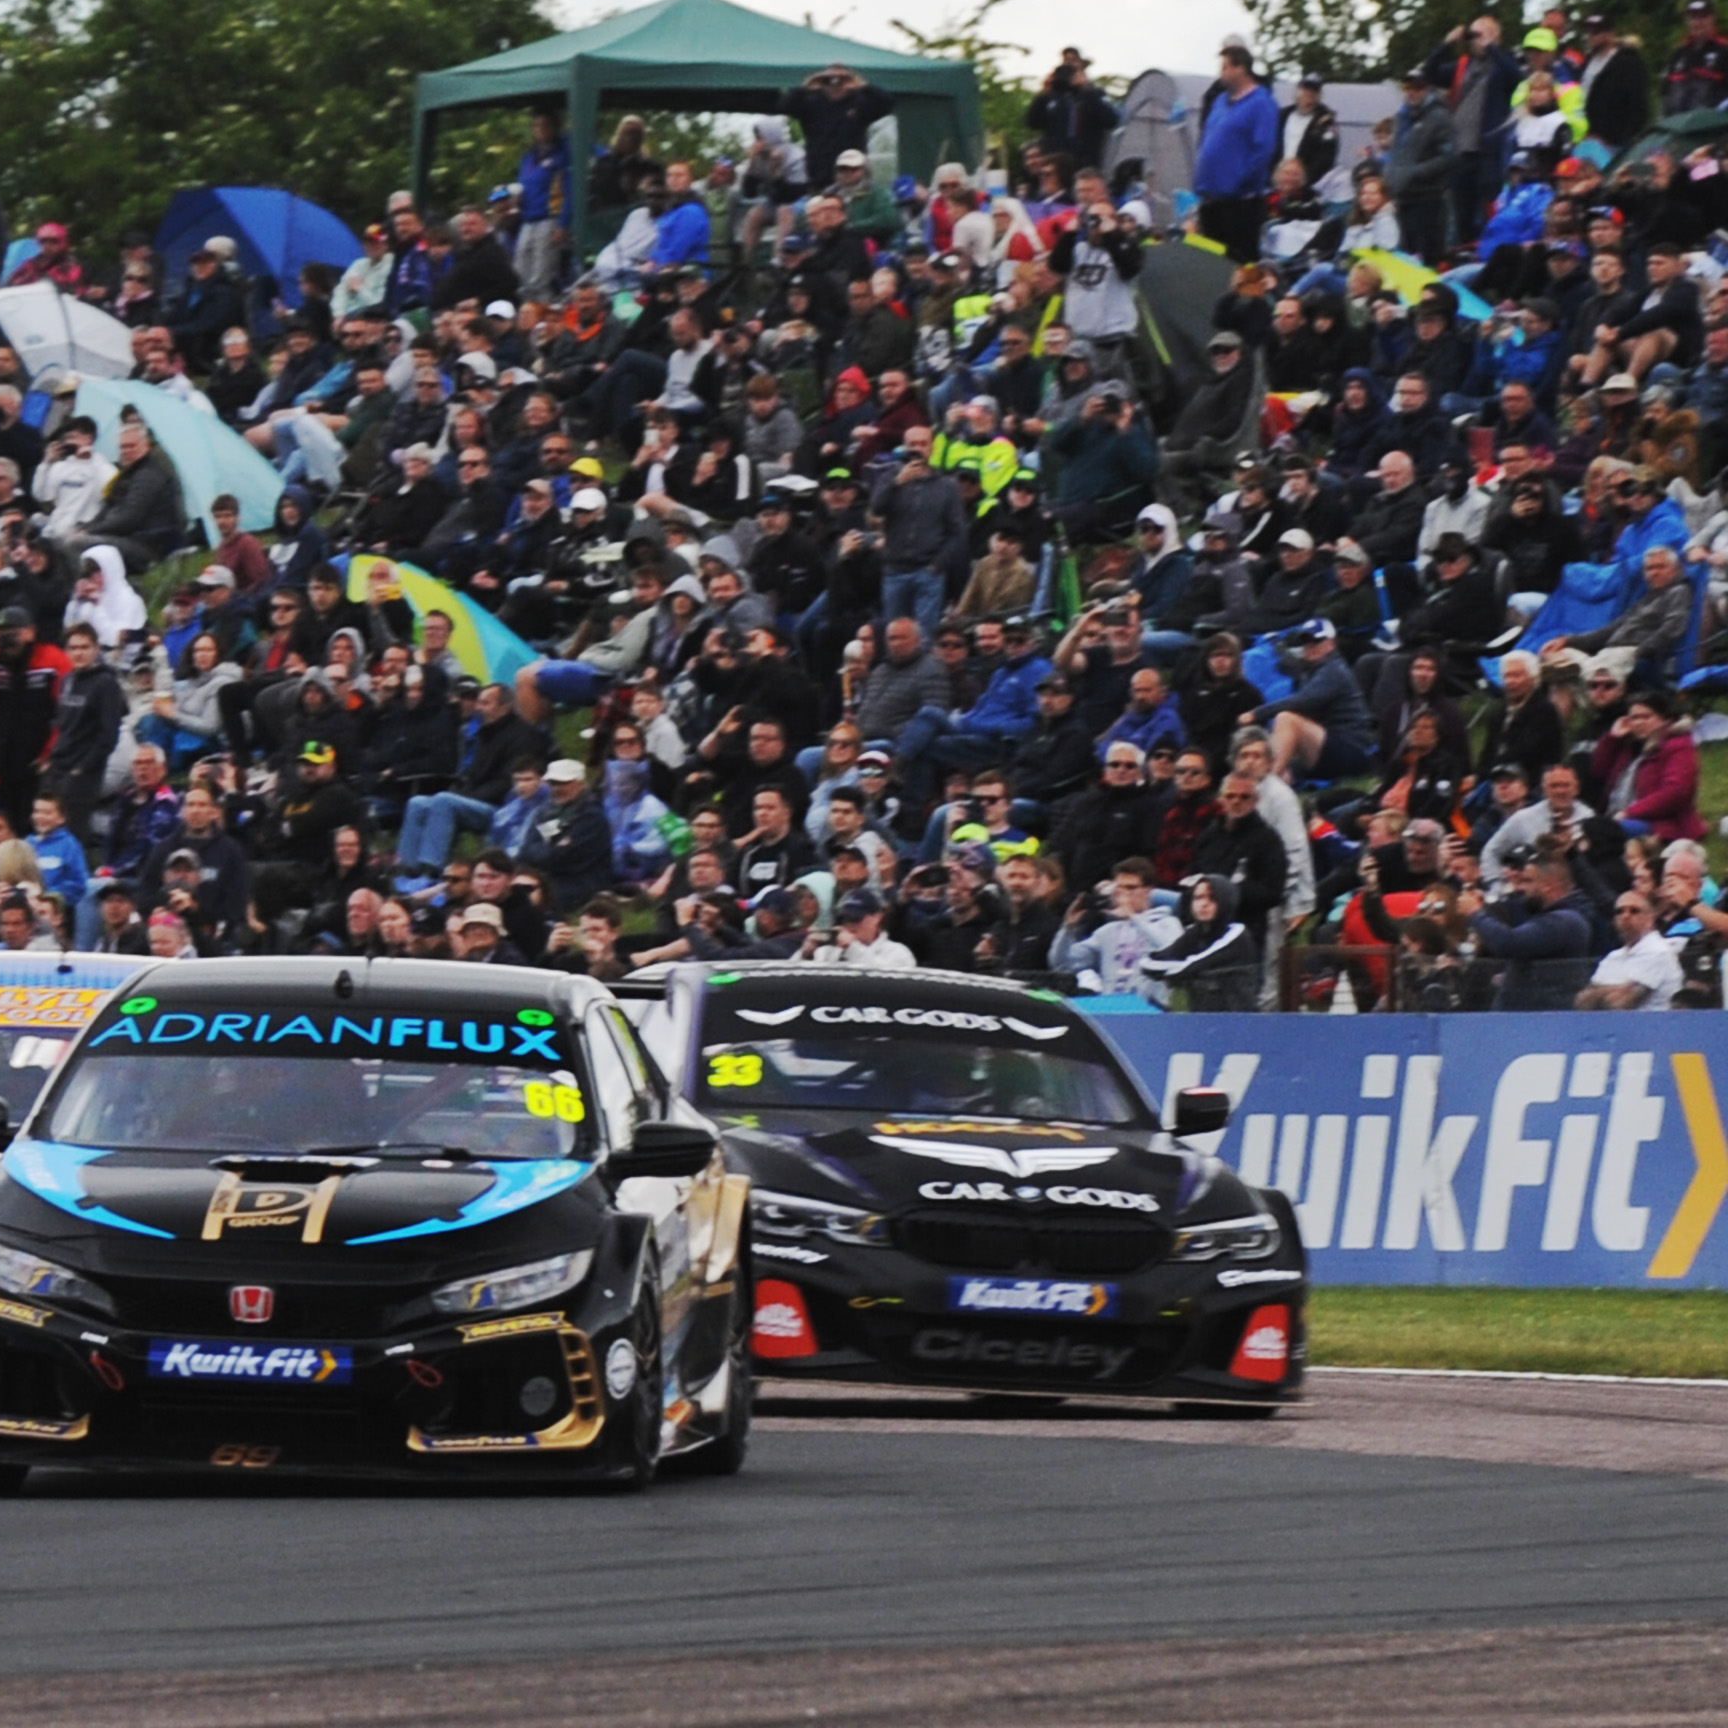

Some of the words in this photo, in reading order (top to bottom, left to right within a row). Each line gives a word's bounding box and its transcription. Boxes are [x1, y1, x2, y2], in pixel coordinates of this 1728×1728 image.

[810, 1006, 893, 1024] CAR
[893, 1008, 1002, 1032] GODS
[708, 1054, 763, 1087] 33
[523, 1082, 584, 1122] 66
[918, 1181, 1014, 1201] CAR
[1045, 1185, 1160, 1212] GODS
